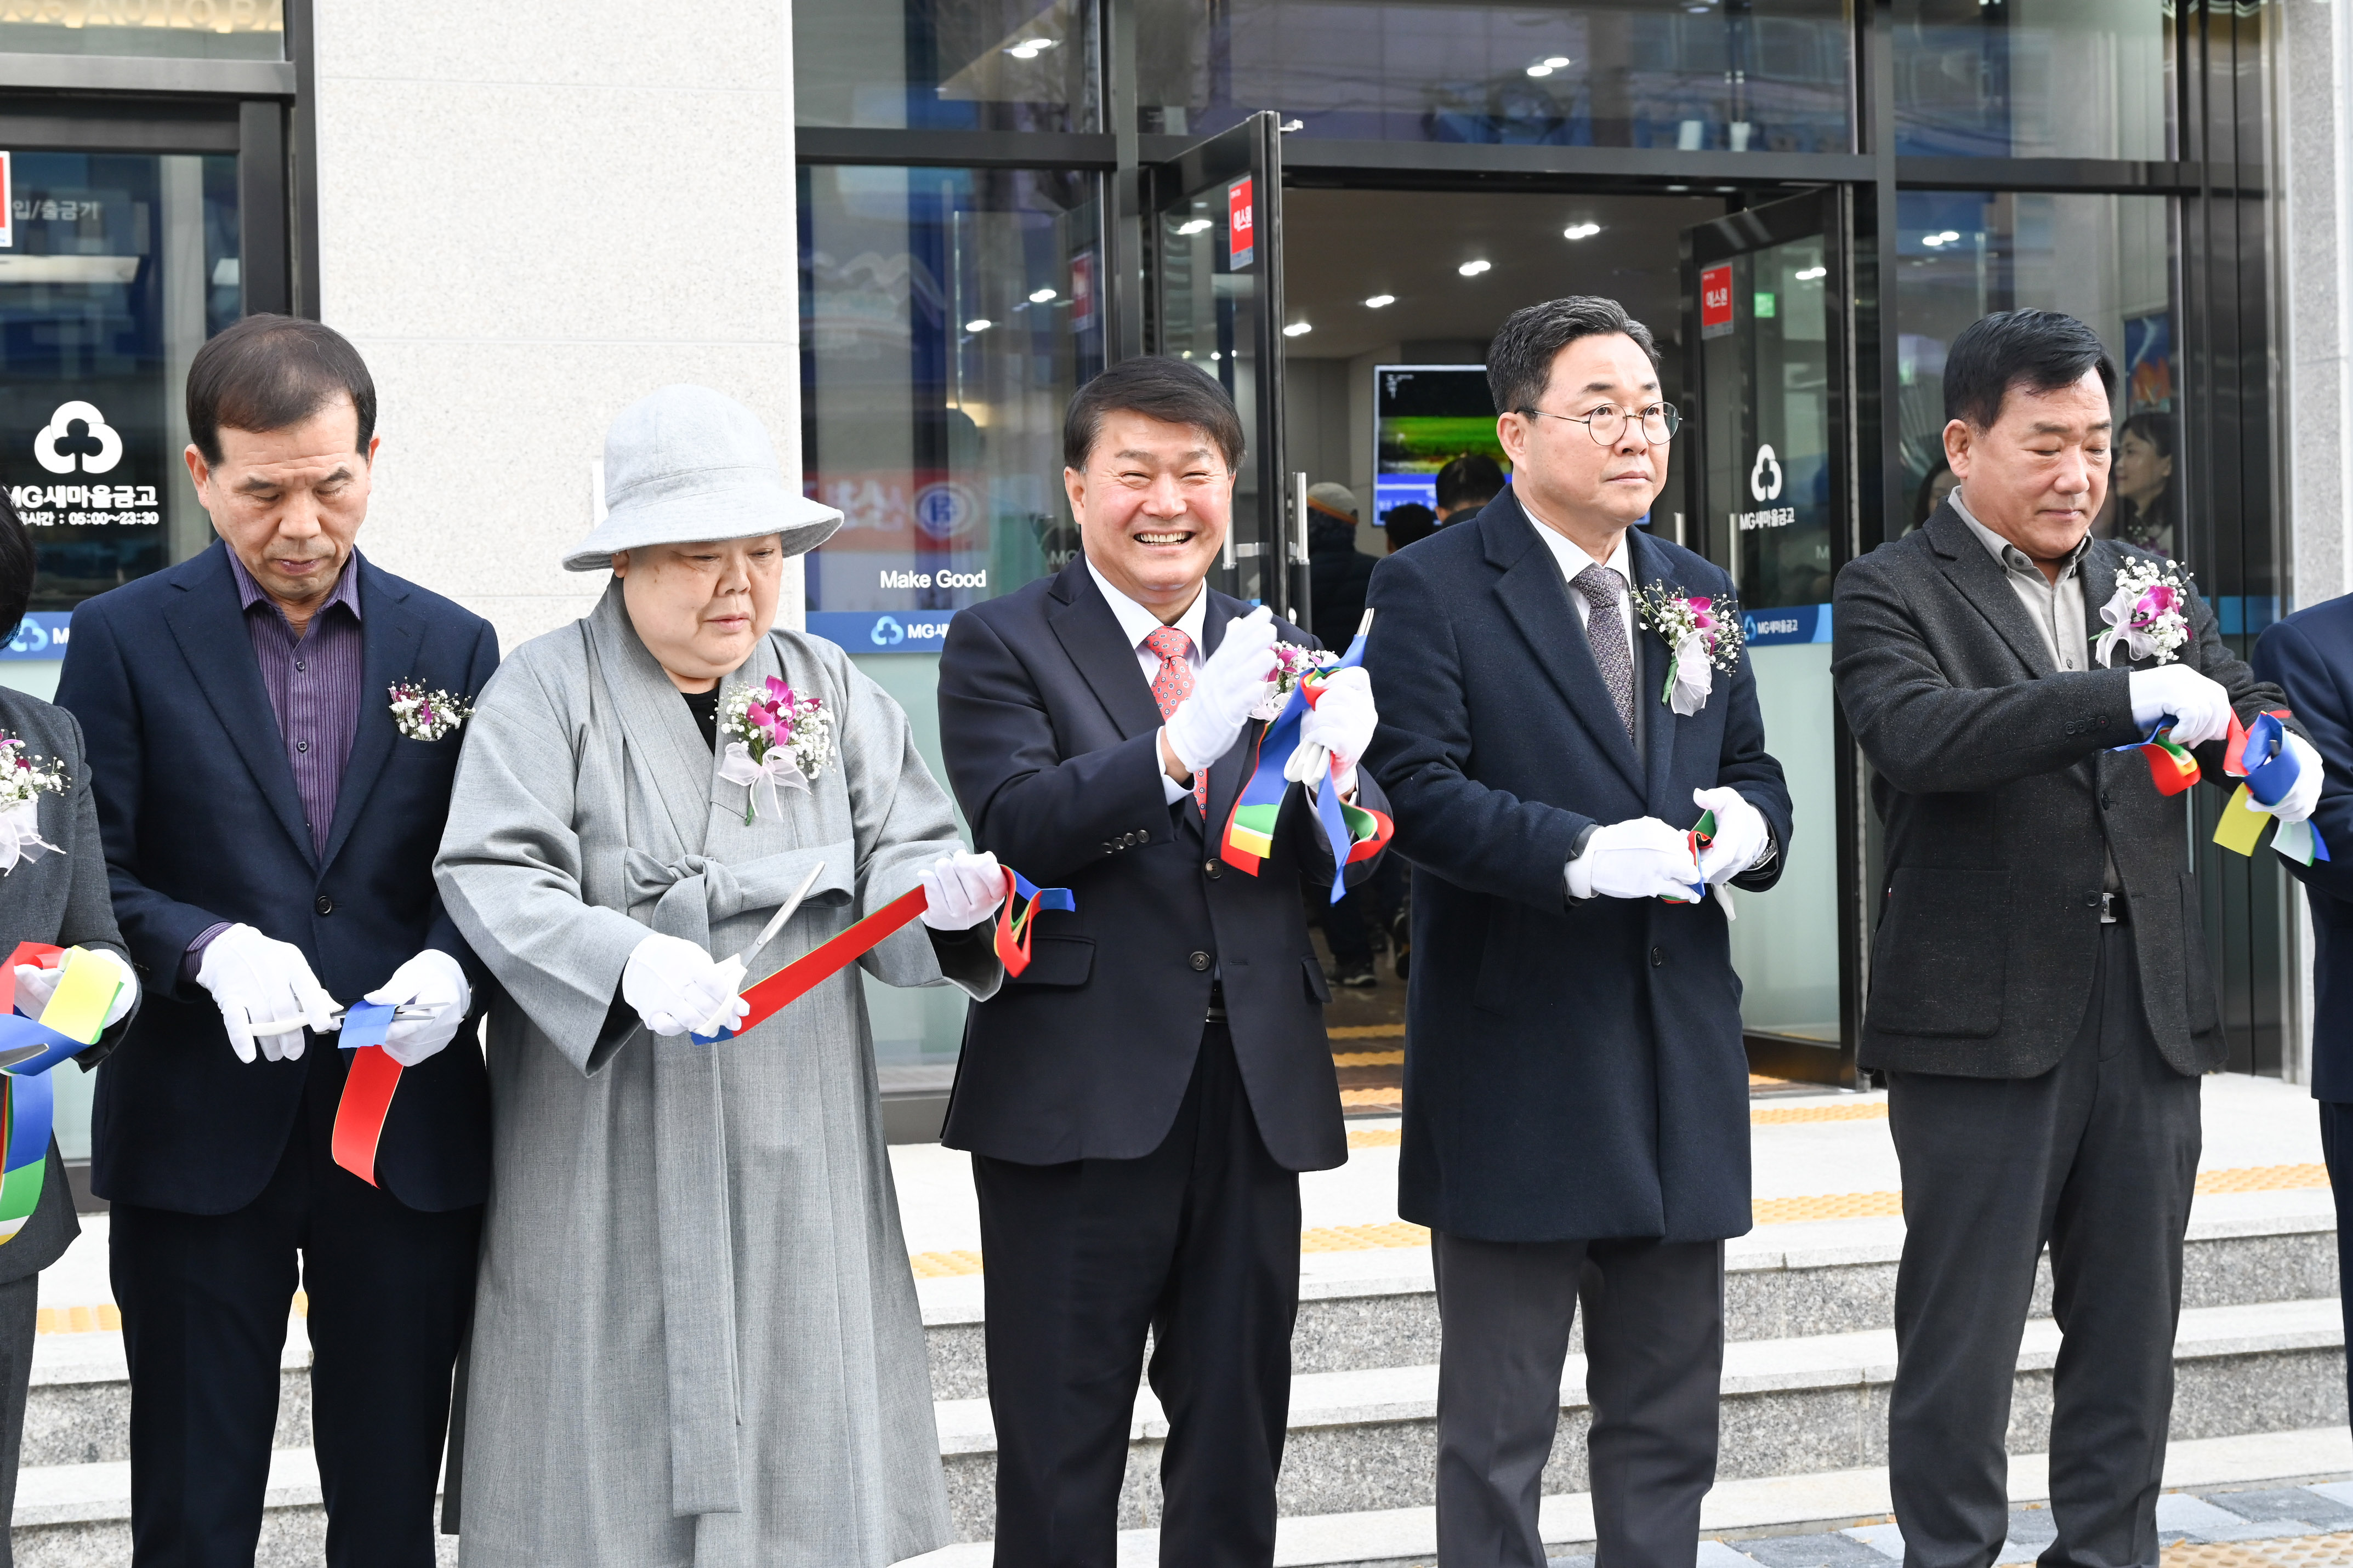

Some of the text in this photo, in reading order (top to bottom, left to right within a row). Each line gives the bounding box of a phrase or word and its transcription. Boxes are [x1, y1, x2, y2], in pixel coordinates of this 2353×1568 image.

[13, 199, 98, 220] 입/출금기
[1706, 287, 1727, 309] 에스원
[1740, 507, 1795, 531] MG새마을금고
[880, 569, 986, 588] Make Good
